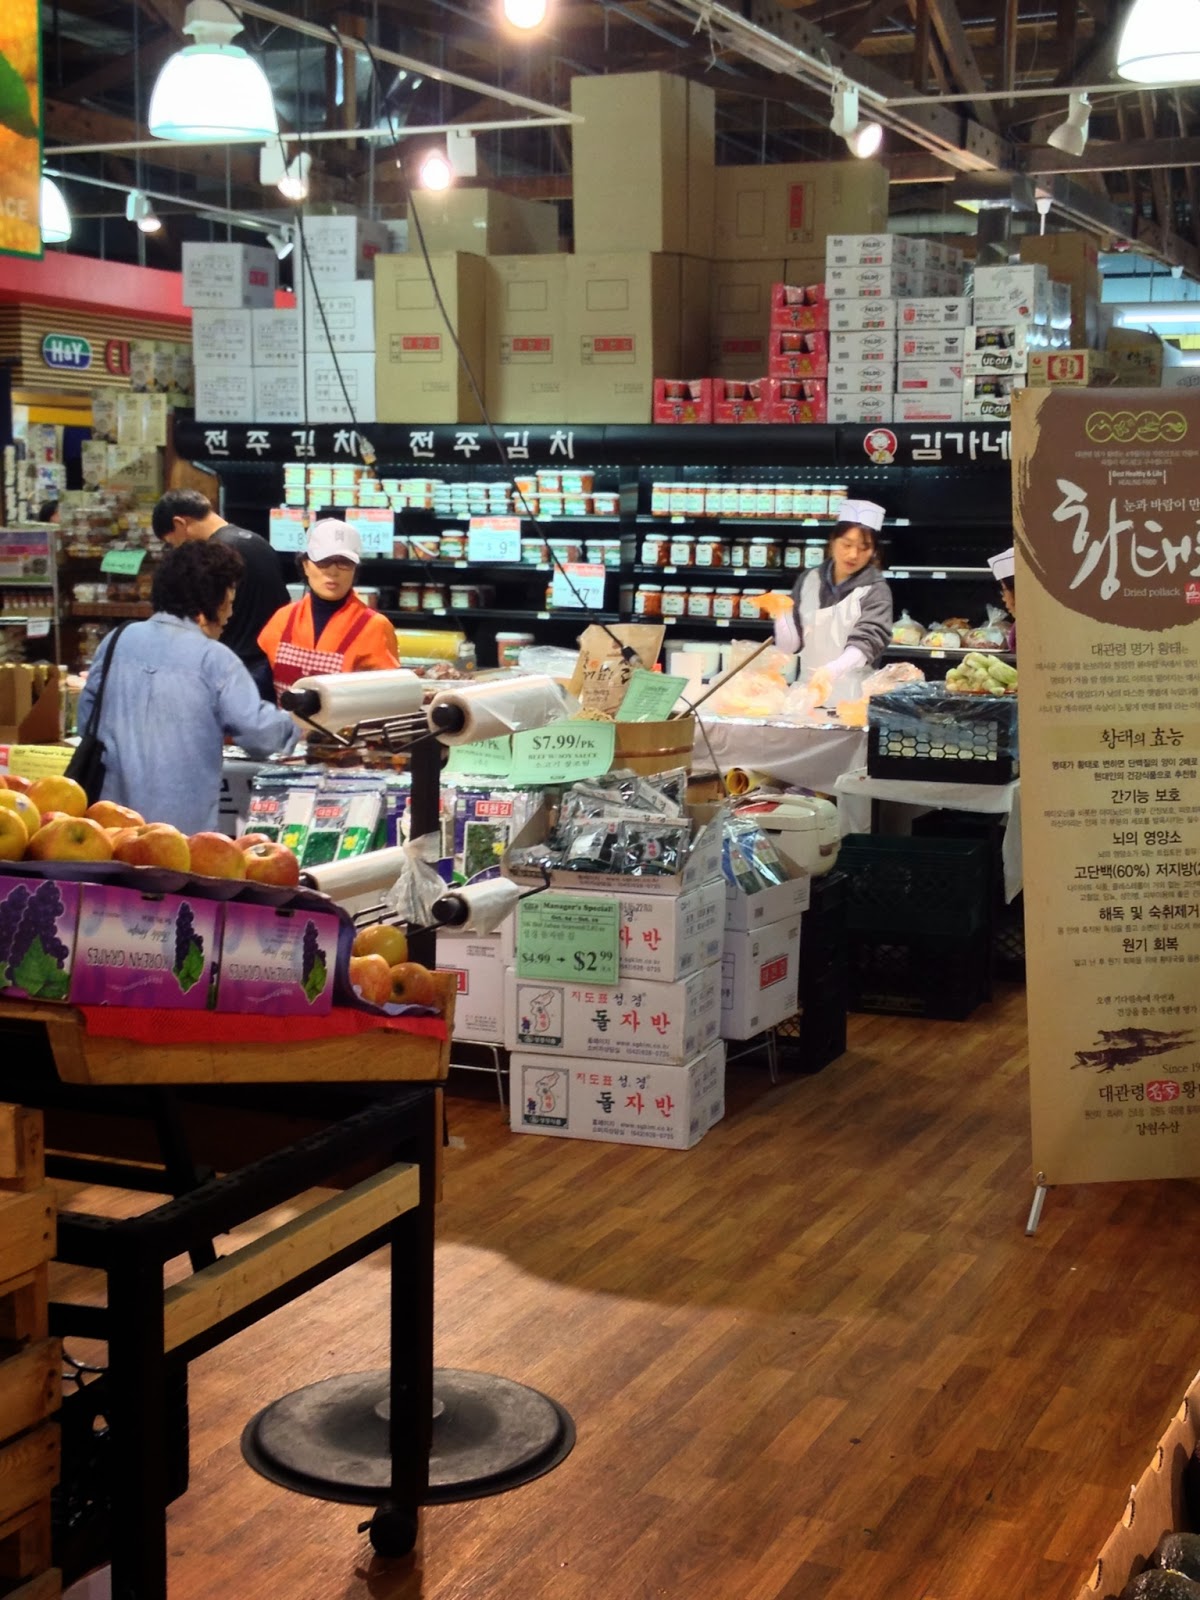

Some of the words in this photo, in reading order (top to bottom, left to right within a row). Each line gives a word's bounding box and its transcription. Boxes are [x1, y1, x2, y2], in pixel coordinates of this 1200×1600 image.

[982, 358, 1009, 366] UDON
[982, 406, 1008, 414] UDON
[1124, 499, 1148, 512] 눈과
[1150, 498, 1186, 512] 바람이
[1124, 588, 1147, 598] Dried
[1149, 587, 1181, 598] pollack
[1091, 642, 1127, 657] 대관령
[1130, 642, 1154, 656] 명가
[532, 734, 595, 750] $7.99/PK
[1100, 728, 1146, 749] 황태의
[1150, 726, 1184, 746] 효능
[1094, 772, 1124, 782] 현대인의
[1126, 770, 1172, 780] 건강식품으로
[1111, 789, 1150, 804] 간기능
[1155, 788, 1182, 802] 보호
[478, 802, 512, 816] 대천김
[1112, 831, 1138, 846] 뇌의
[1143, 830, 1182, 845] 영양소
[1074, 863, 1150, 879] 고단백(60%)
[544, 902, 582, 912] Manager's
[1099, 906, 1125, 921] 해독
[1130, 906, 1143, 920] 및
[1148, 904, 1200, 919] 숙취제거
[1122, 938, 1148, 953] 원기
[1153, 936, 1179, 952] 회복
[87, 947, 126, 968] GRAPES
[129, 951, 168, 970] KOREAN
[522, 952, 551, 964] $4.99
[571, 990, 608, 1005] 지도표
[1162, 1063, 1189, 1073] Since
[576, 1072, 612, 1086] 지도표
[1099, 1083, 1145, 1103] 대관령
[1136, 1121, 1180, 1136] 강원수산
